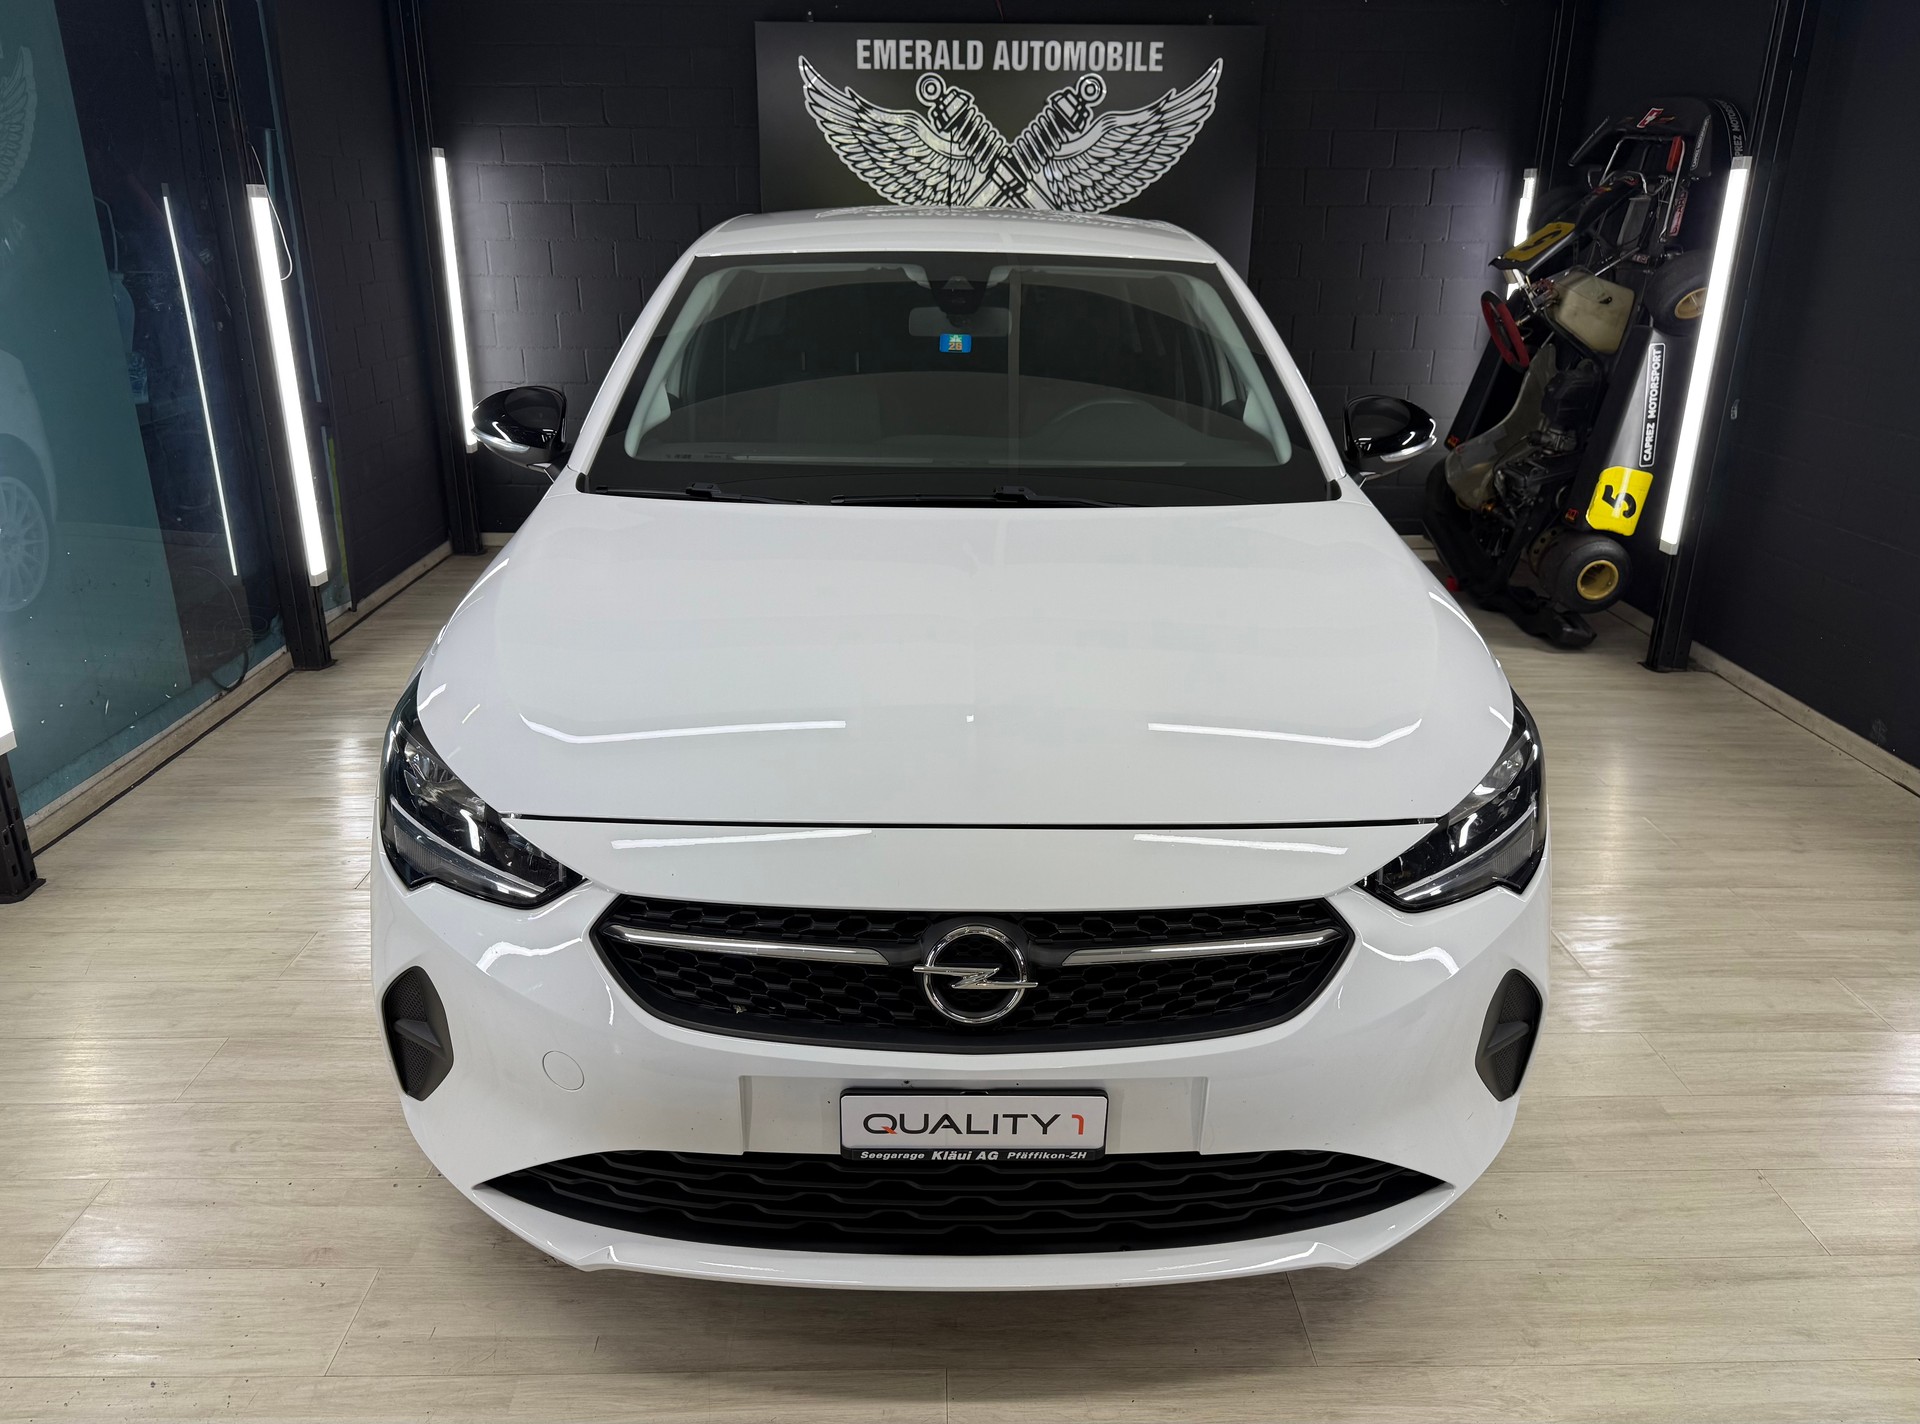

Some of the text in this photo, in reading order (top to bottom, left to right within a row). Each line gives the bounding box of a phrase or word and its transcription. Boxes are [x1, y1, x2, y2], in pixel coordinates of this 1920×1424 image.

[856, 39, 1165, 73] EMERALD AUTOMOBILE
[1732, 134, 1744, 158] PREZ
[1642, 349, 1662, 462] CAPREZ MOTORSPORT
[1602, 485, 1637, 519] 5
[862, 1113, 1085, 1136] QUALITY 1
[860, 1150, 1087, 1161] Seegarage Kläui AG Pfäffikon-ZH
